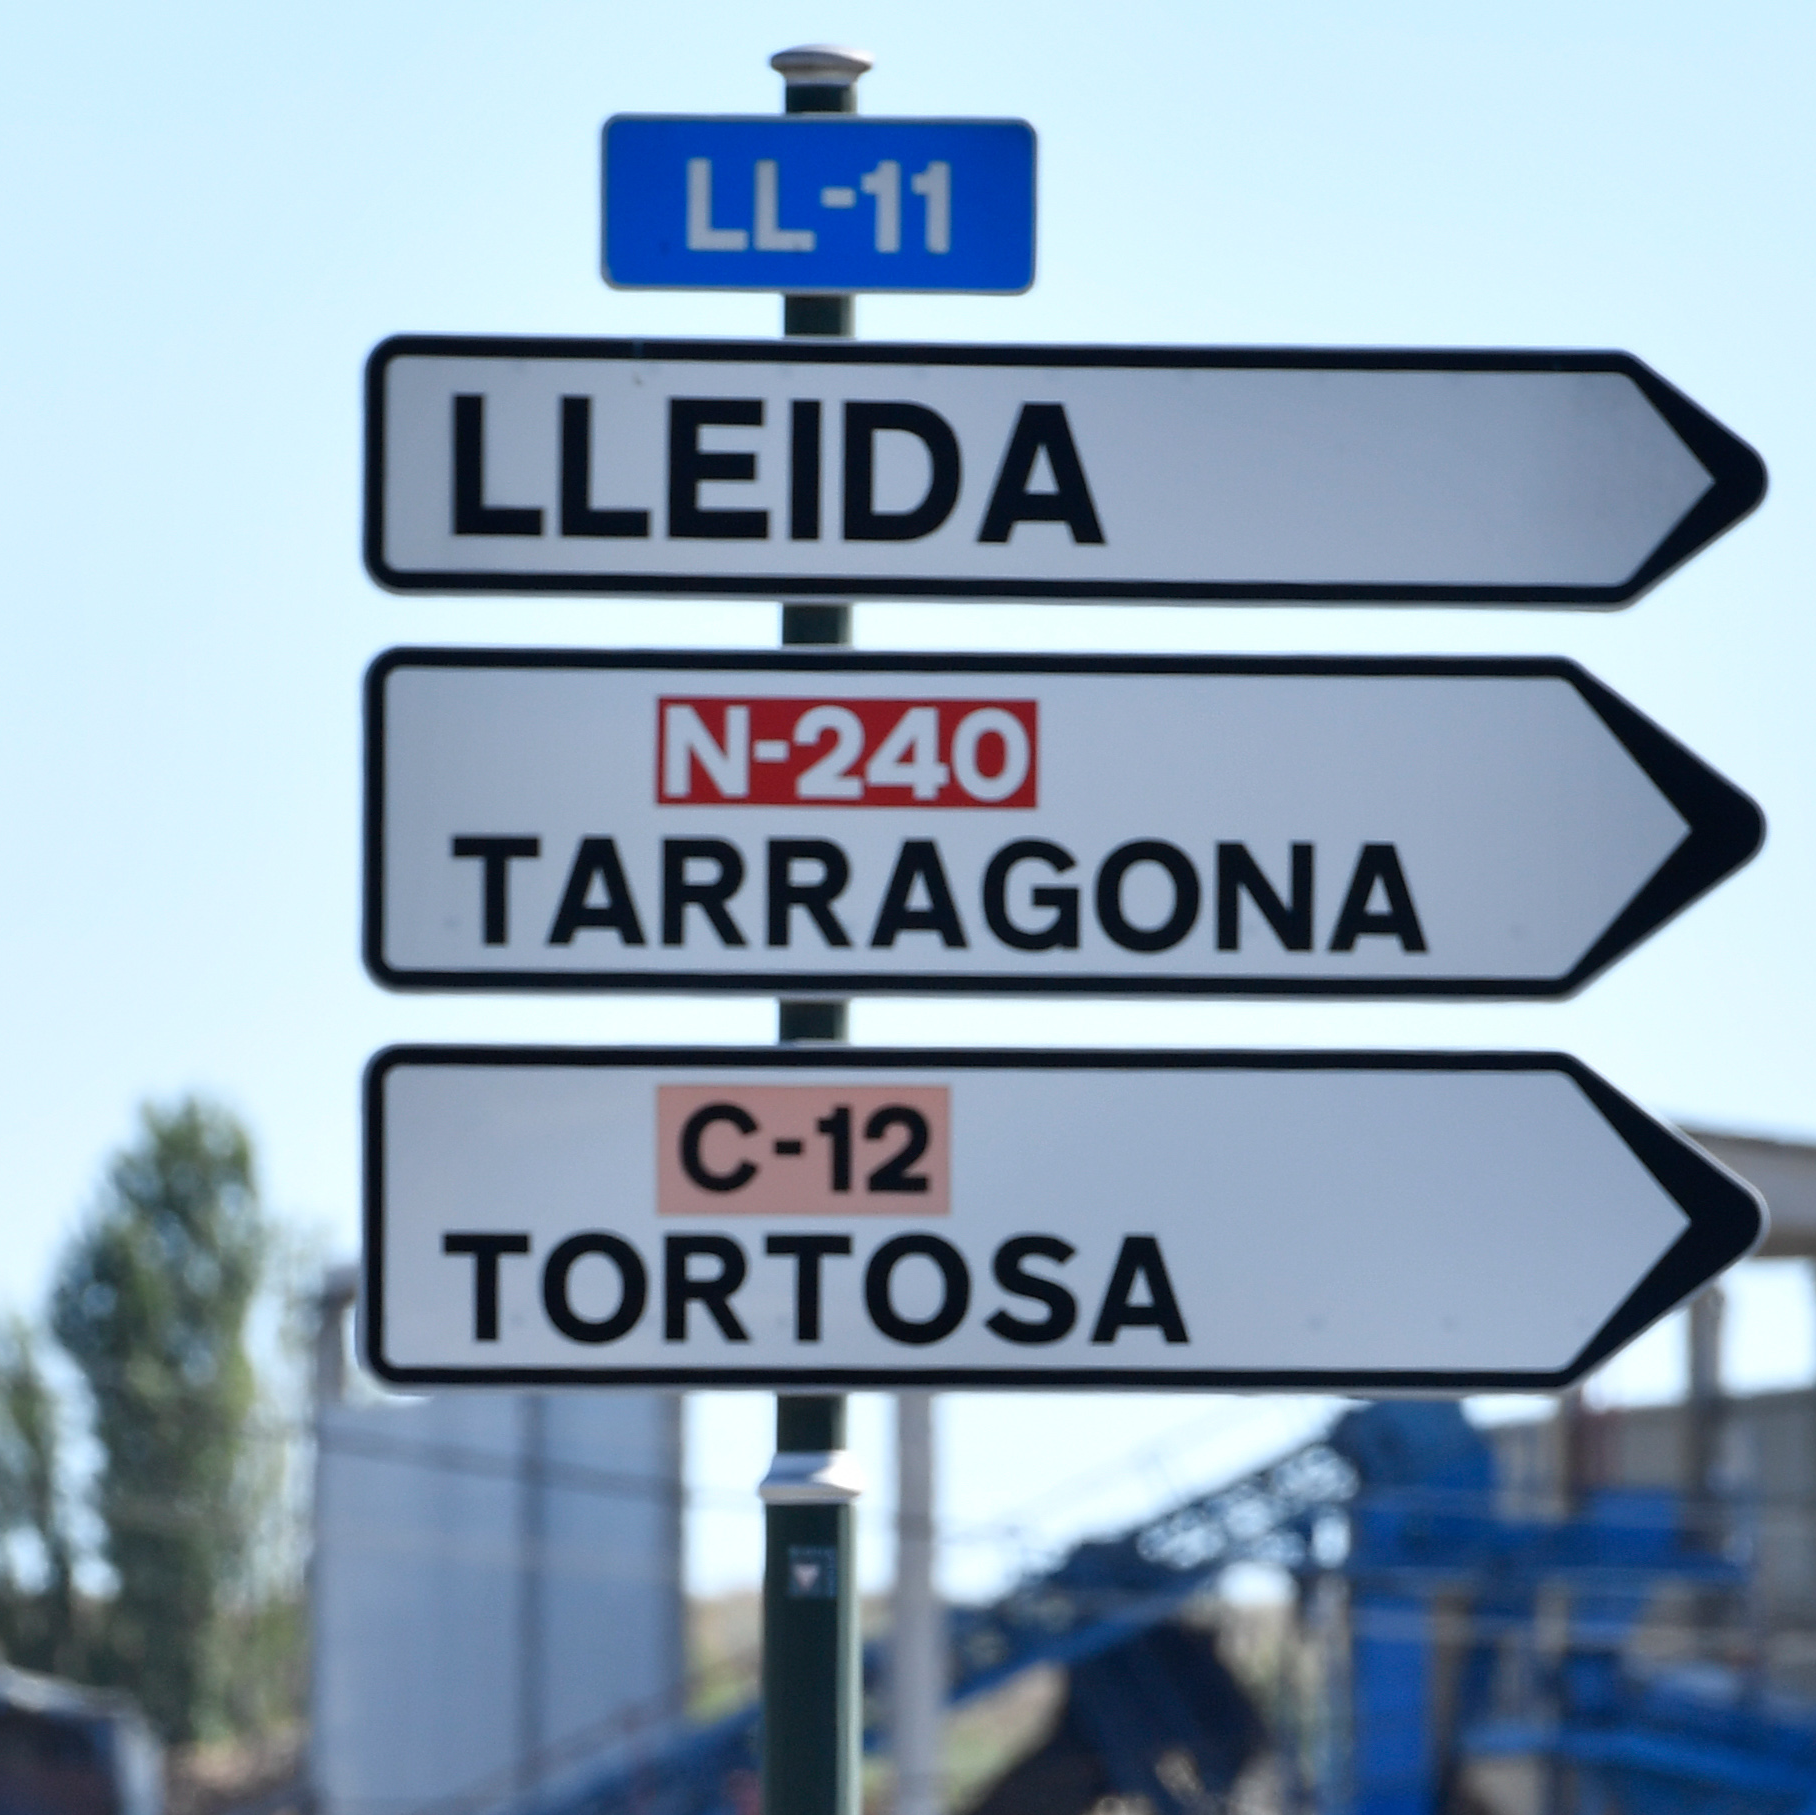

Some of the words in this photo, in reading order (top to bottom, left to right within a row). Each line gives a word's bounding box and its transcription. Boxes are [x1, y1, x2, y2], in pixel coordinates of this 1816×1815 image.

[685, 160, 953, 254] LL-11
[449, 393, 1106, 545] LLEIDA
[661, 705, 1030, 800] N-240
[451, 835, 1428, 954] TARRAGONA
[678, 1102, 931, 1195] C-12
[443, 1232, 1190, 1347] TORTOSA
